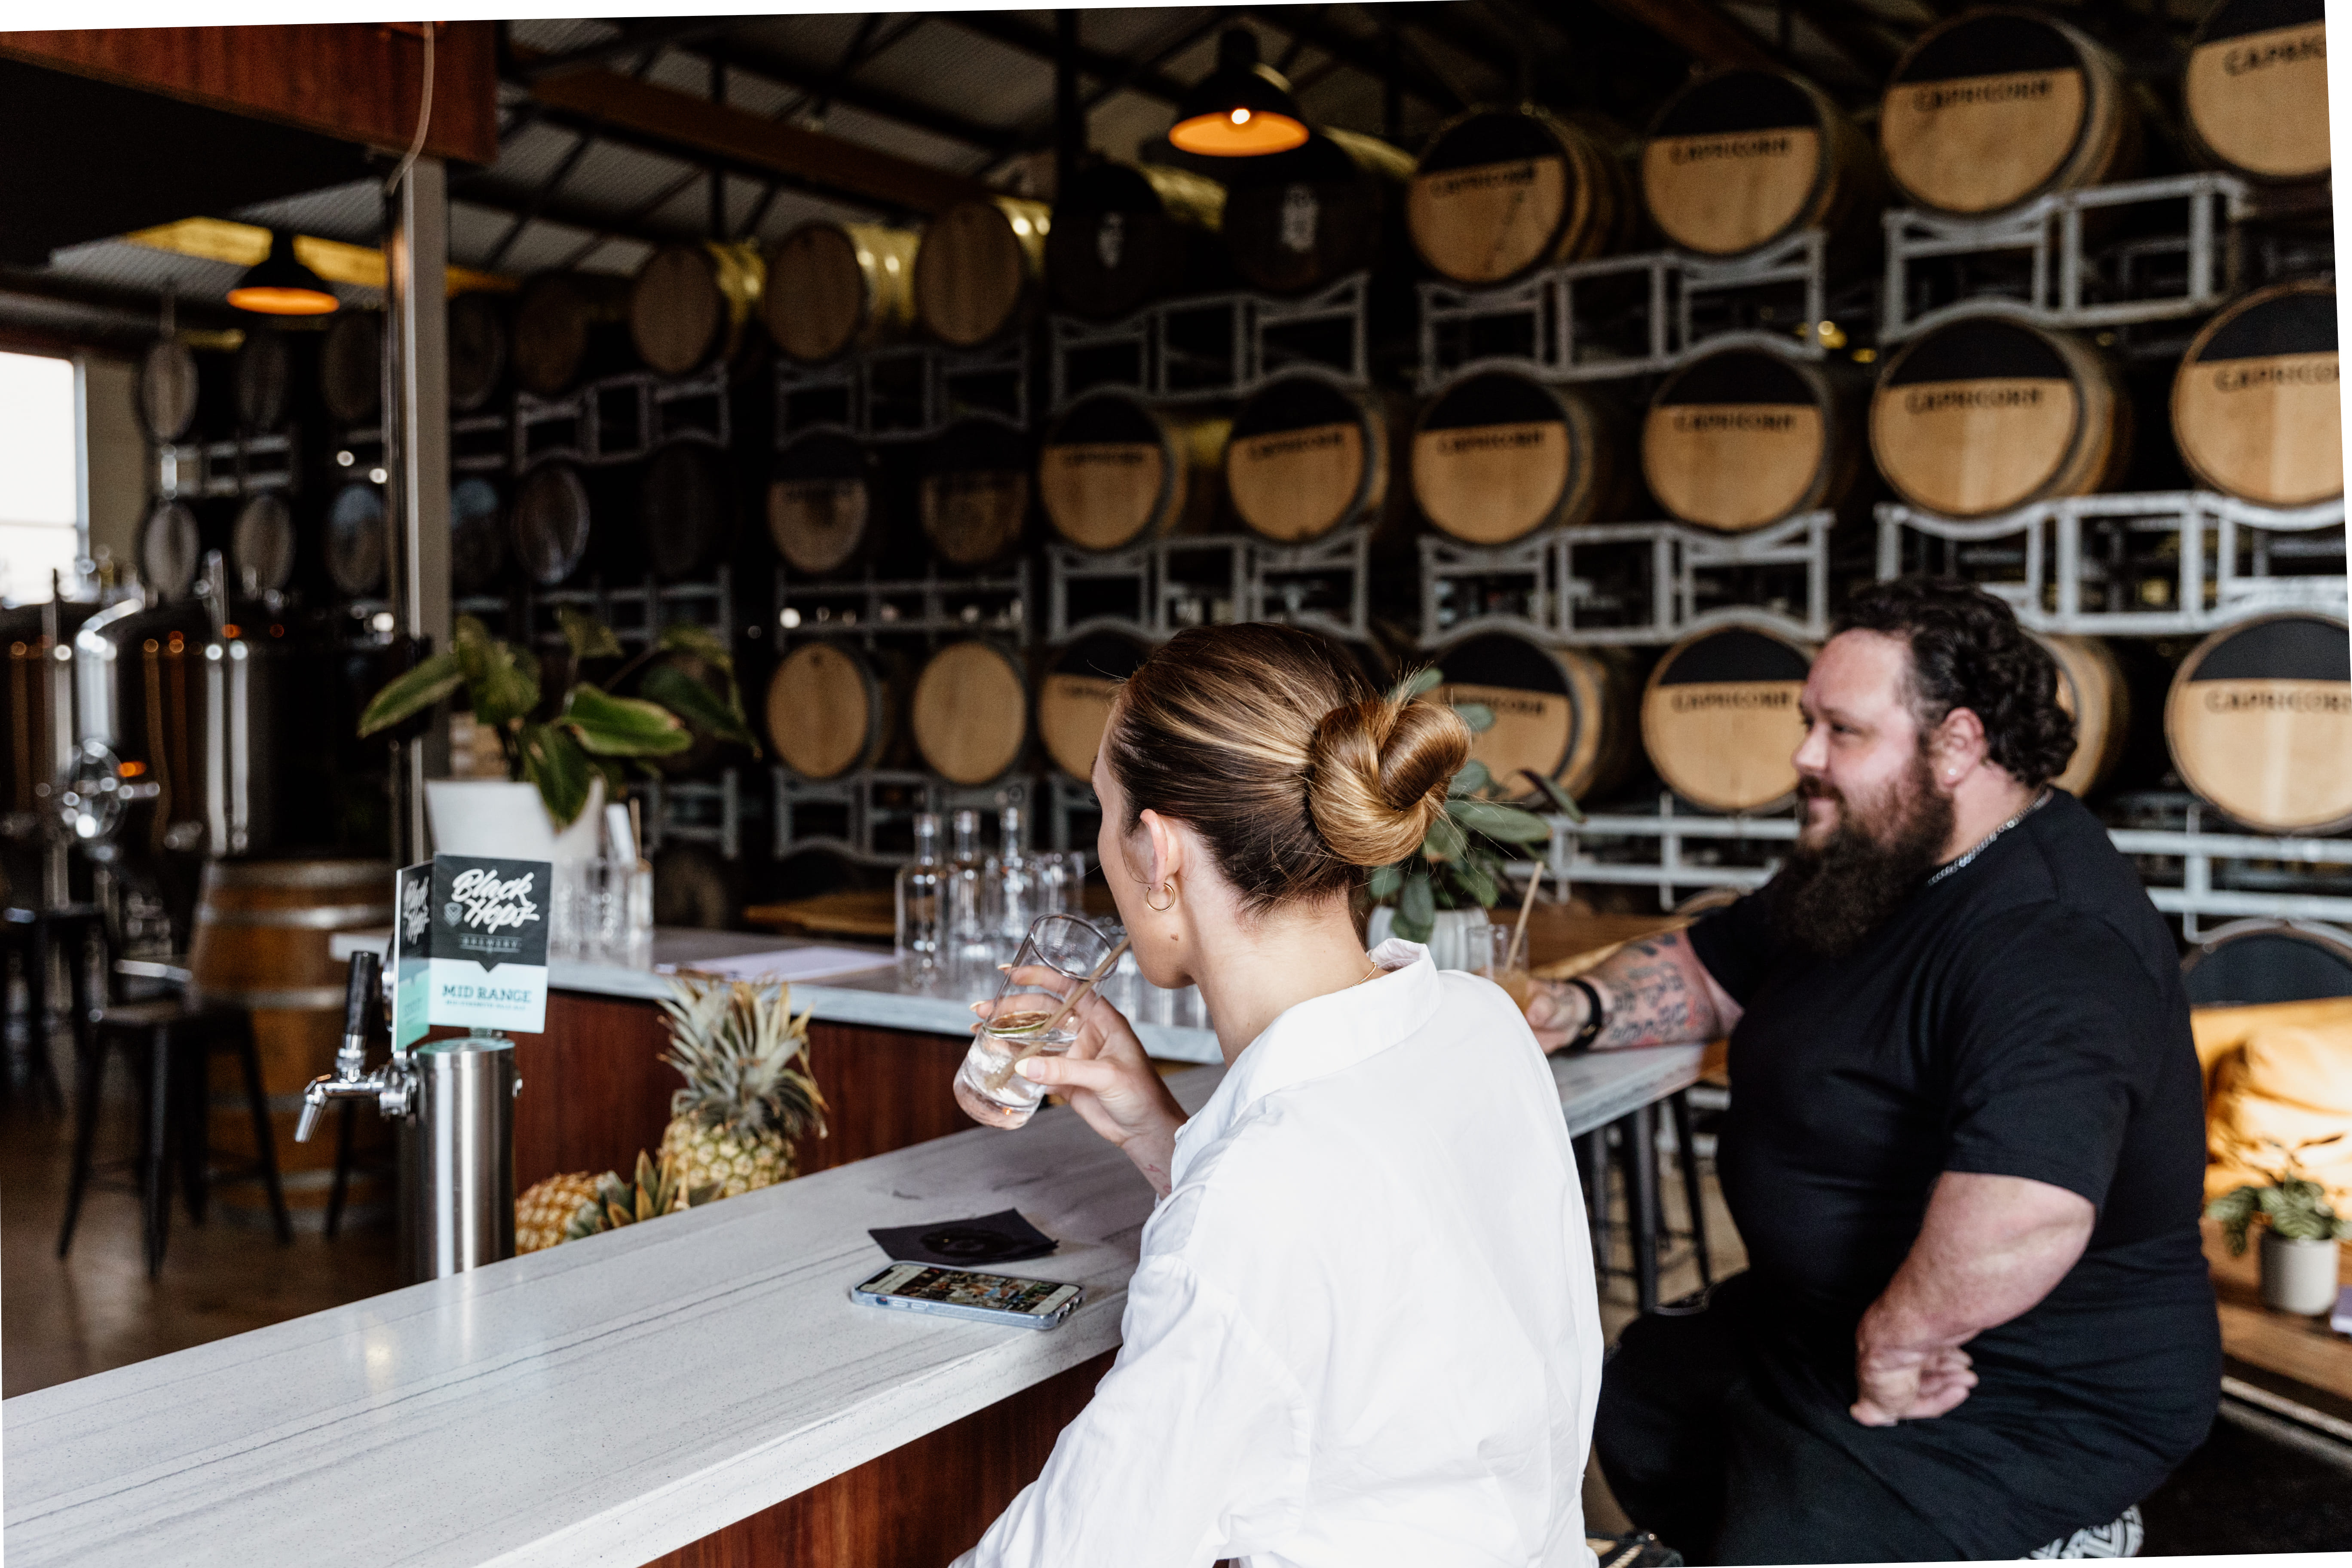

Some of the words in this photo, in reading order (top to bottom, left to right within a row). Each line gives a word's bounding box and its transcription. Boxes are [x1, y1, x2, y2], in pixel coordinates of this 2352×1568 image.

[451, 868, 534, 907] Black
[463, 897, 540, 934] Hops
[442, 983, 474, 998] MID
[477, 986, 532, 1003] RANGE
